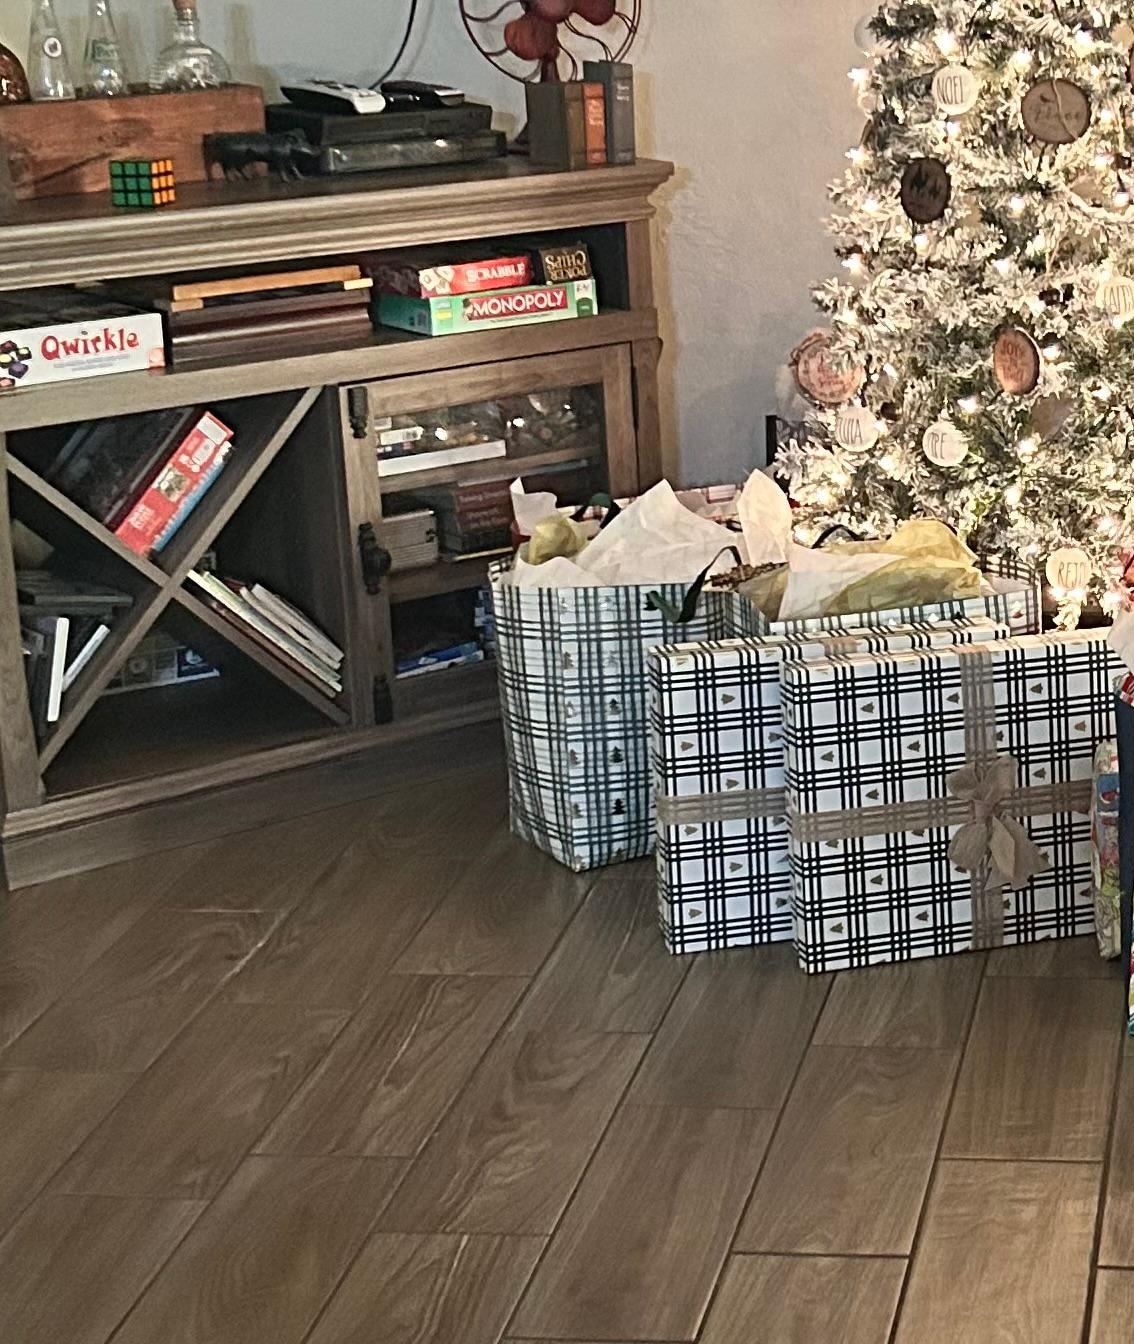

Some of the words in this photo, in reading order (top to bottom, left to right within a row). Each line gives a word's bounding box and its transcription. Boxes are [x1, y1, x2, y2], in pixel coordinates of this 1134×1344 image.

[937, 76, 963, 104] NOEL
[465, 262, 525, 283] SCRABBLE
[545, 250, 586, 269] CHIPS
[473, 290, 564, 317] MONOPOLY
[41, 327, 139, 360] Qwirkle
